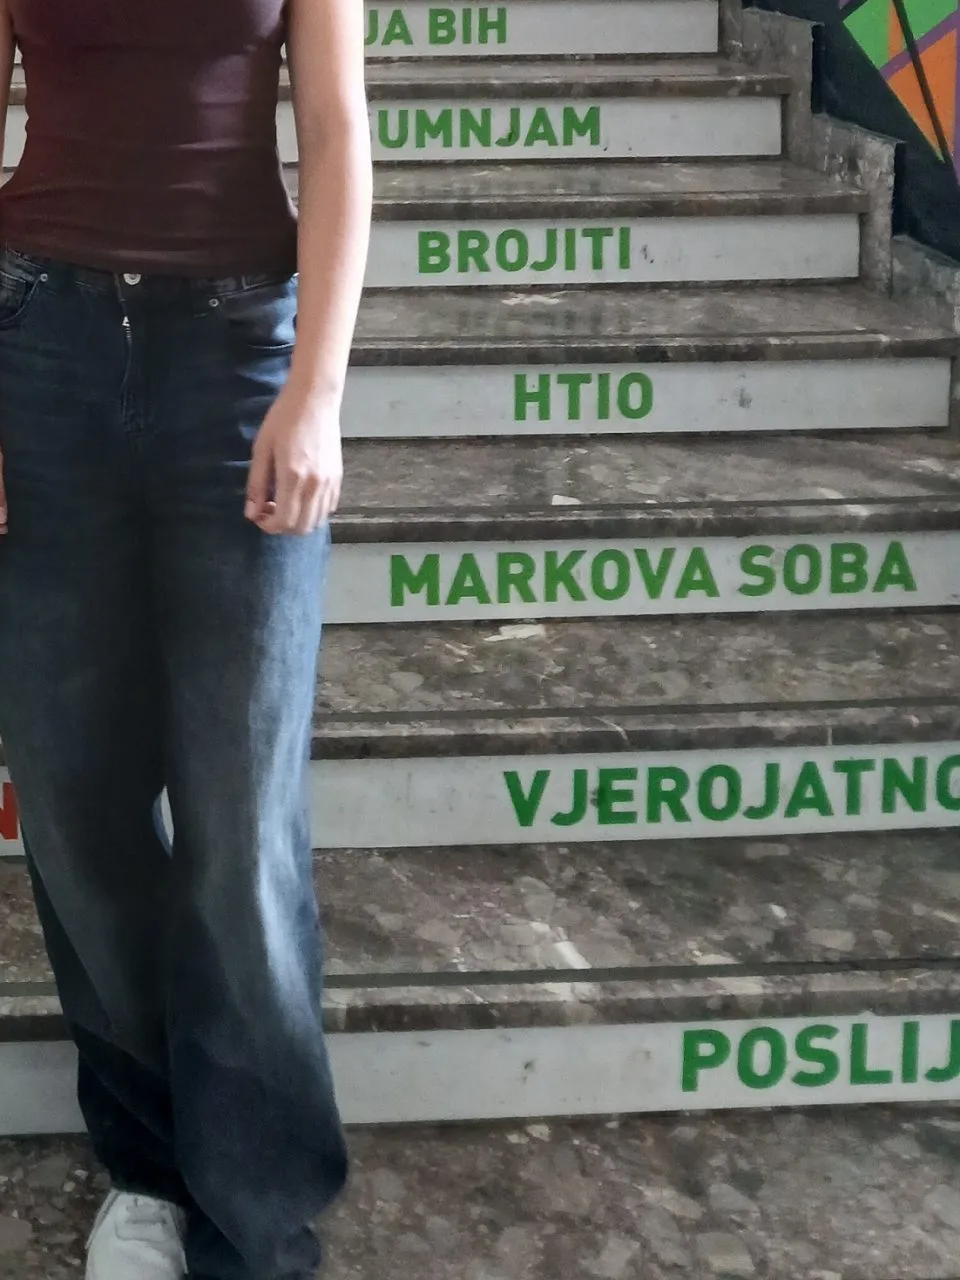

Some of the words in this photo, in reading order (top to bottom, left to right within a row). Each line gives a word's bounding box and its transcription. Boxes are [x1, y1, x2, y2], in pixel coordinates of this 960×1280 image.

[364, 9, 414, 46] JA
[428, 7, 507, 45] BIH
[417, 226, 631, 274] BROJITI
[514, 372, 654, 421] HTIO
[389, 547, 720, 607] MARKOVA
[737, 540, 918, 597] SOBA
[502, 754, 960, 828] VJEROJATNO
